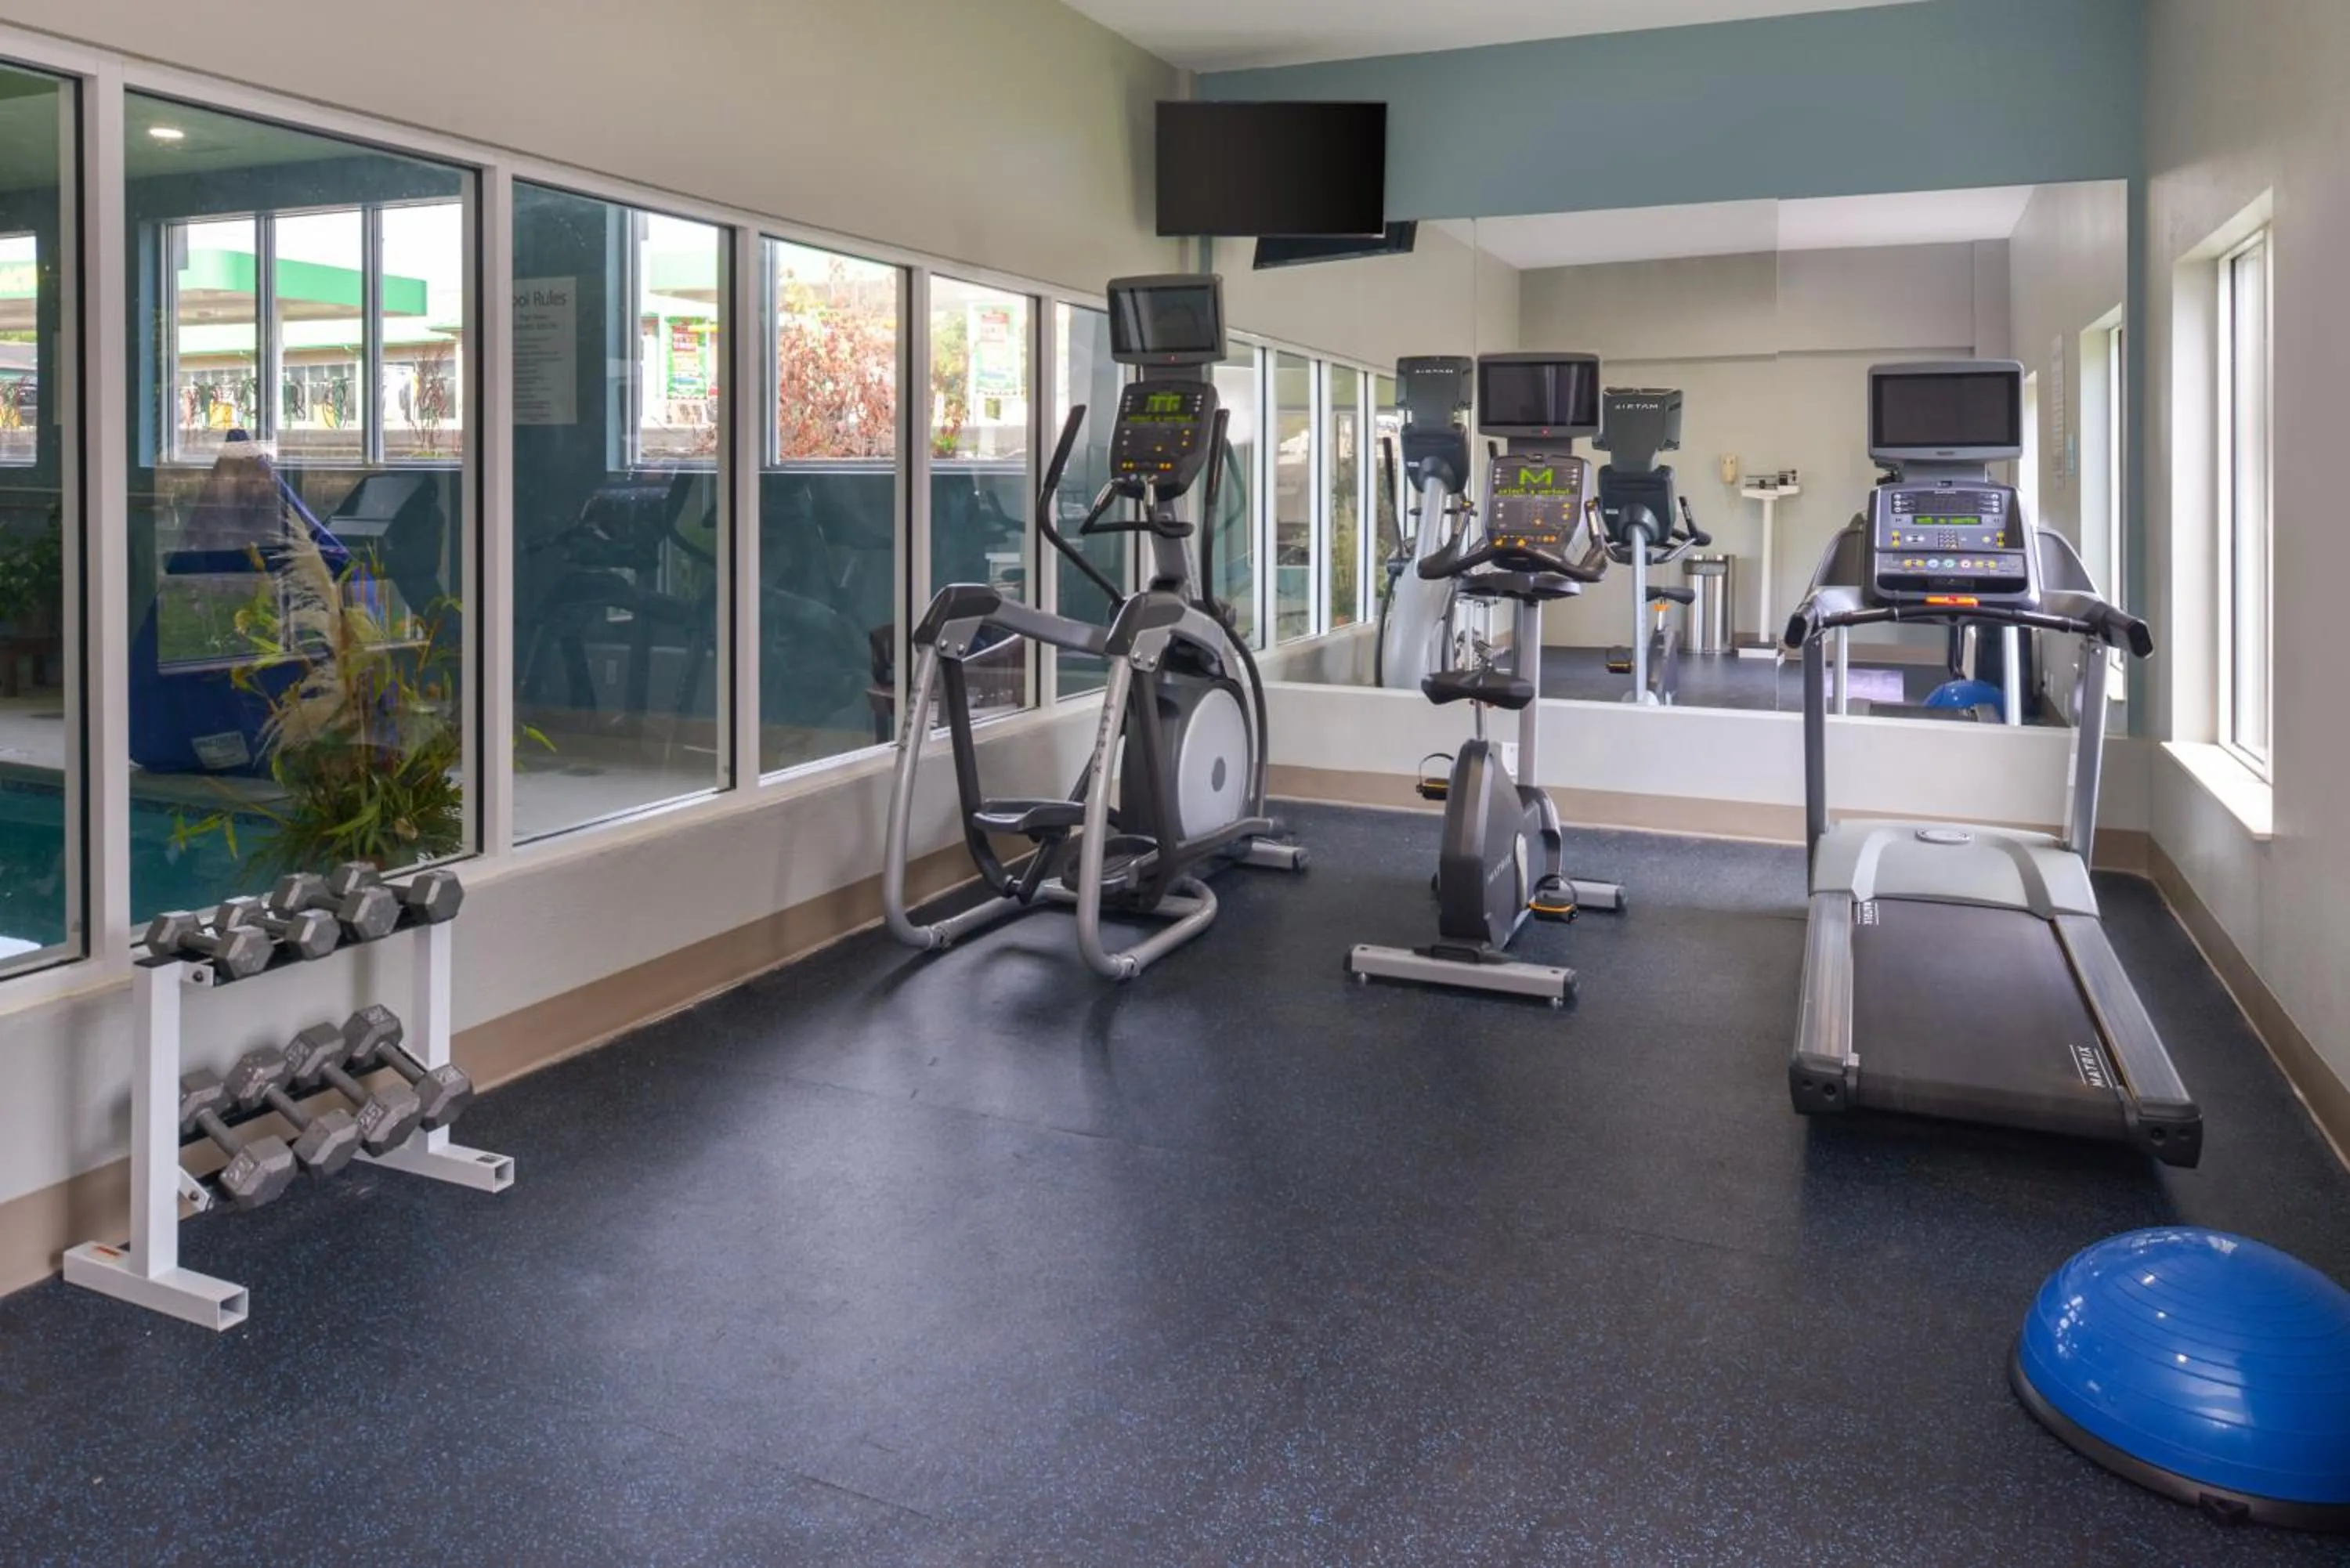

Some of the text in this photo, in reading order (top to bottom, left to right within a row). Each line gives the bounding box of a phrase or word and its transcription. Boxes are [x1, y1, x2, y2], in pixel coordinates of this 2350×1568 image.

[512, 289, 567, 309] ool Rules
[2077, 1046, 2106, 1088] MATRIX
